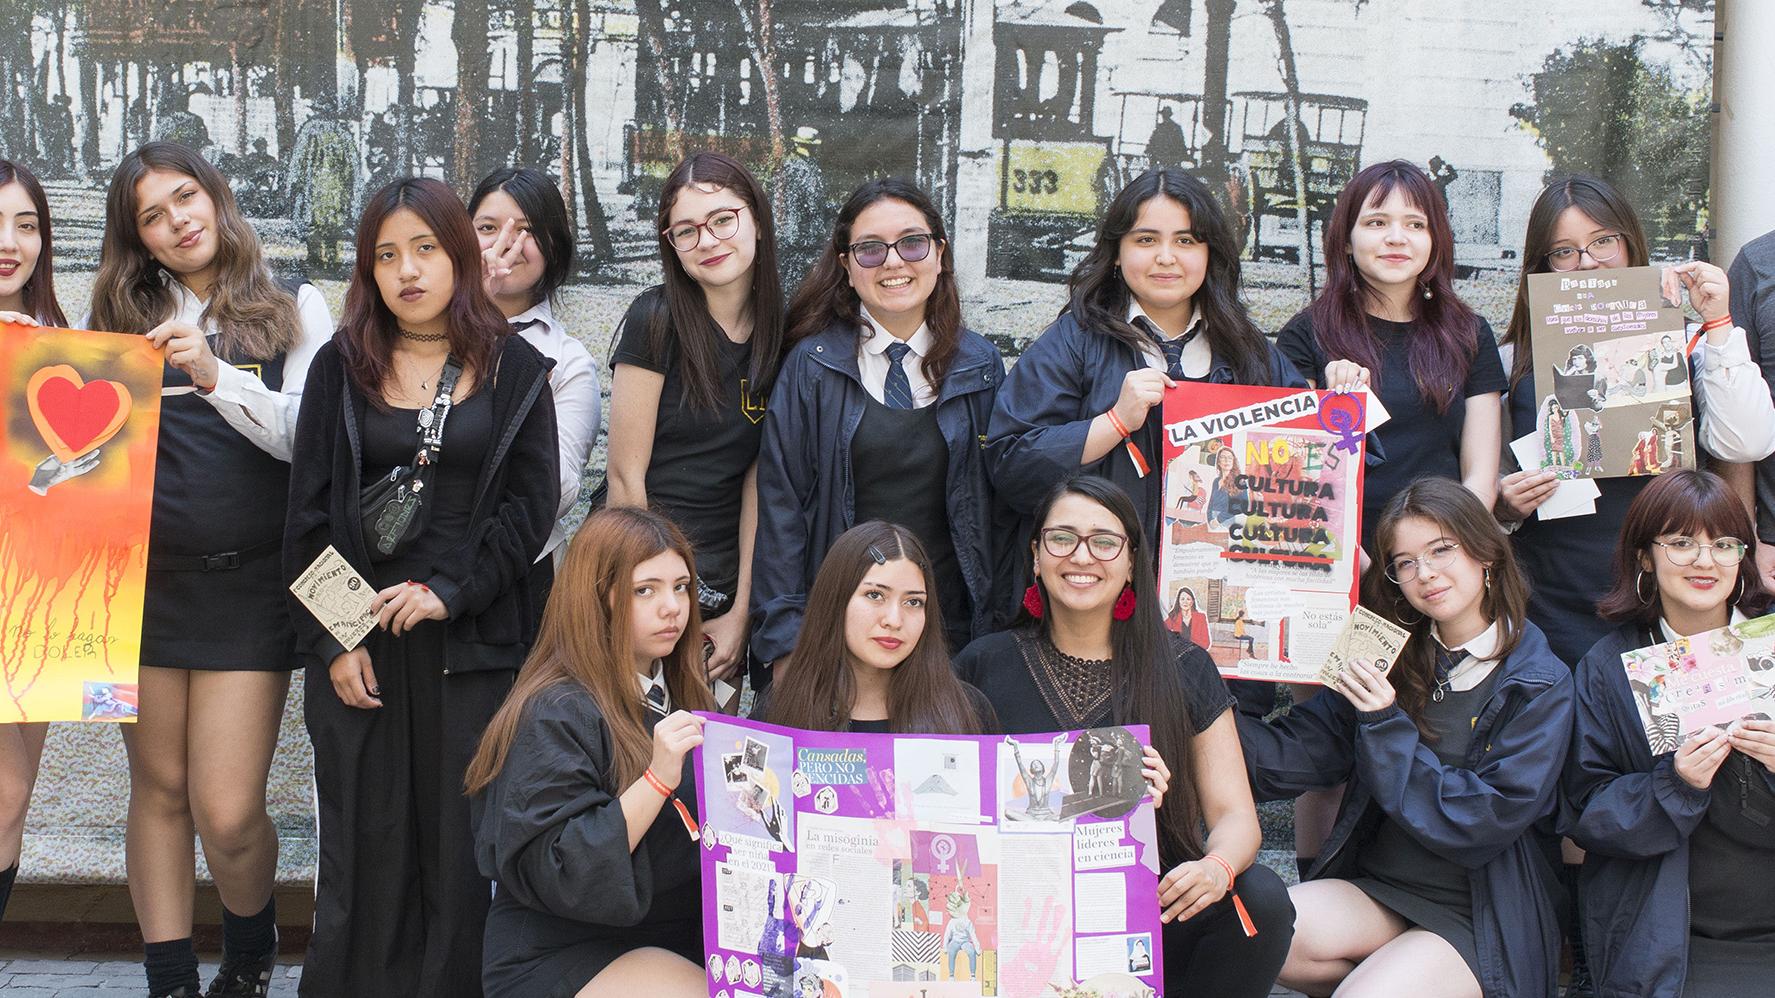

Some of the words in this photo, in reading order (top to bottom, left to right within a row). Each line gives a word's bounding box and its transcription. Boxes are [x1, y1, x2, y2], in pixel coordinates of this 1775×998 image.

[1013, 169, 1058, 194] 333
[1171, 424, 1198, 443] LA
[1200, 394, 1317, 437] VIOLENCIA
[1246, 437, 1291, 466] NO
[1304, 442, 1340, 471] ES
[1234, 473, 1335, 501] CULTURA
[1228, 499, 1328, 523] CULTURA
[1229, 522, 1331, 545] CULTURA
[308, 564, 347, 600] MOVIMIENTO
[1303, 610, 1317, 620] No
[1318, 610, 1344, 621] estás
[1353, 623, 1397, 655] MOVIMIENTO
[798, 748, 867, 764] Cansadas,
[799, 762, 832, 774] PERO
[836, 762, 856, 774] NO
[806, 773, 864, 785] ENCIDAS
[806, 830, 821, 841] La
[824, 832, 880, 848] misoginia
[1076, 825, 1123, 839] Mujeres
[1077, 853, 1092, 864] en
[1094, 849, 1135, 862] ciencia
